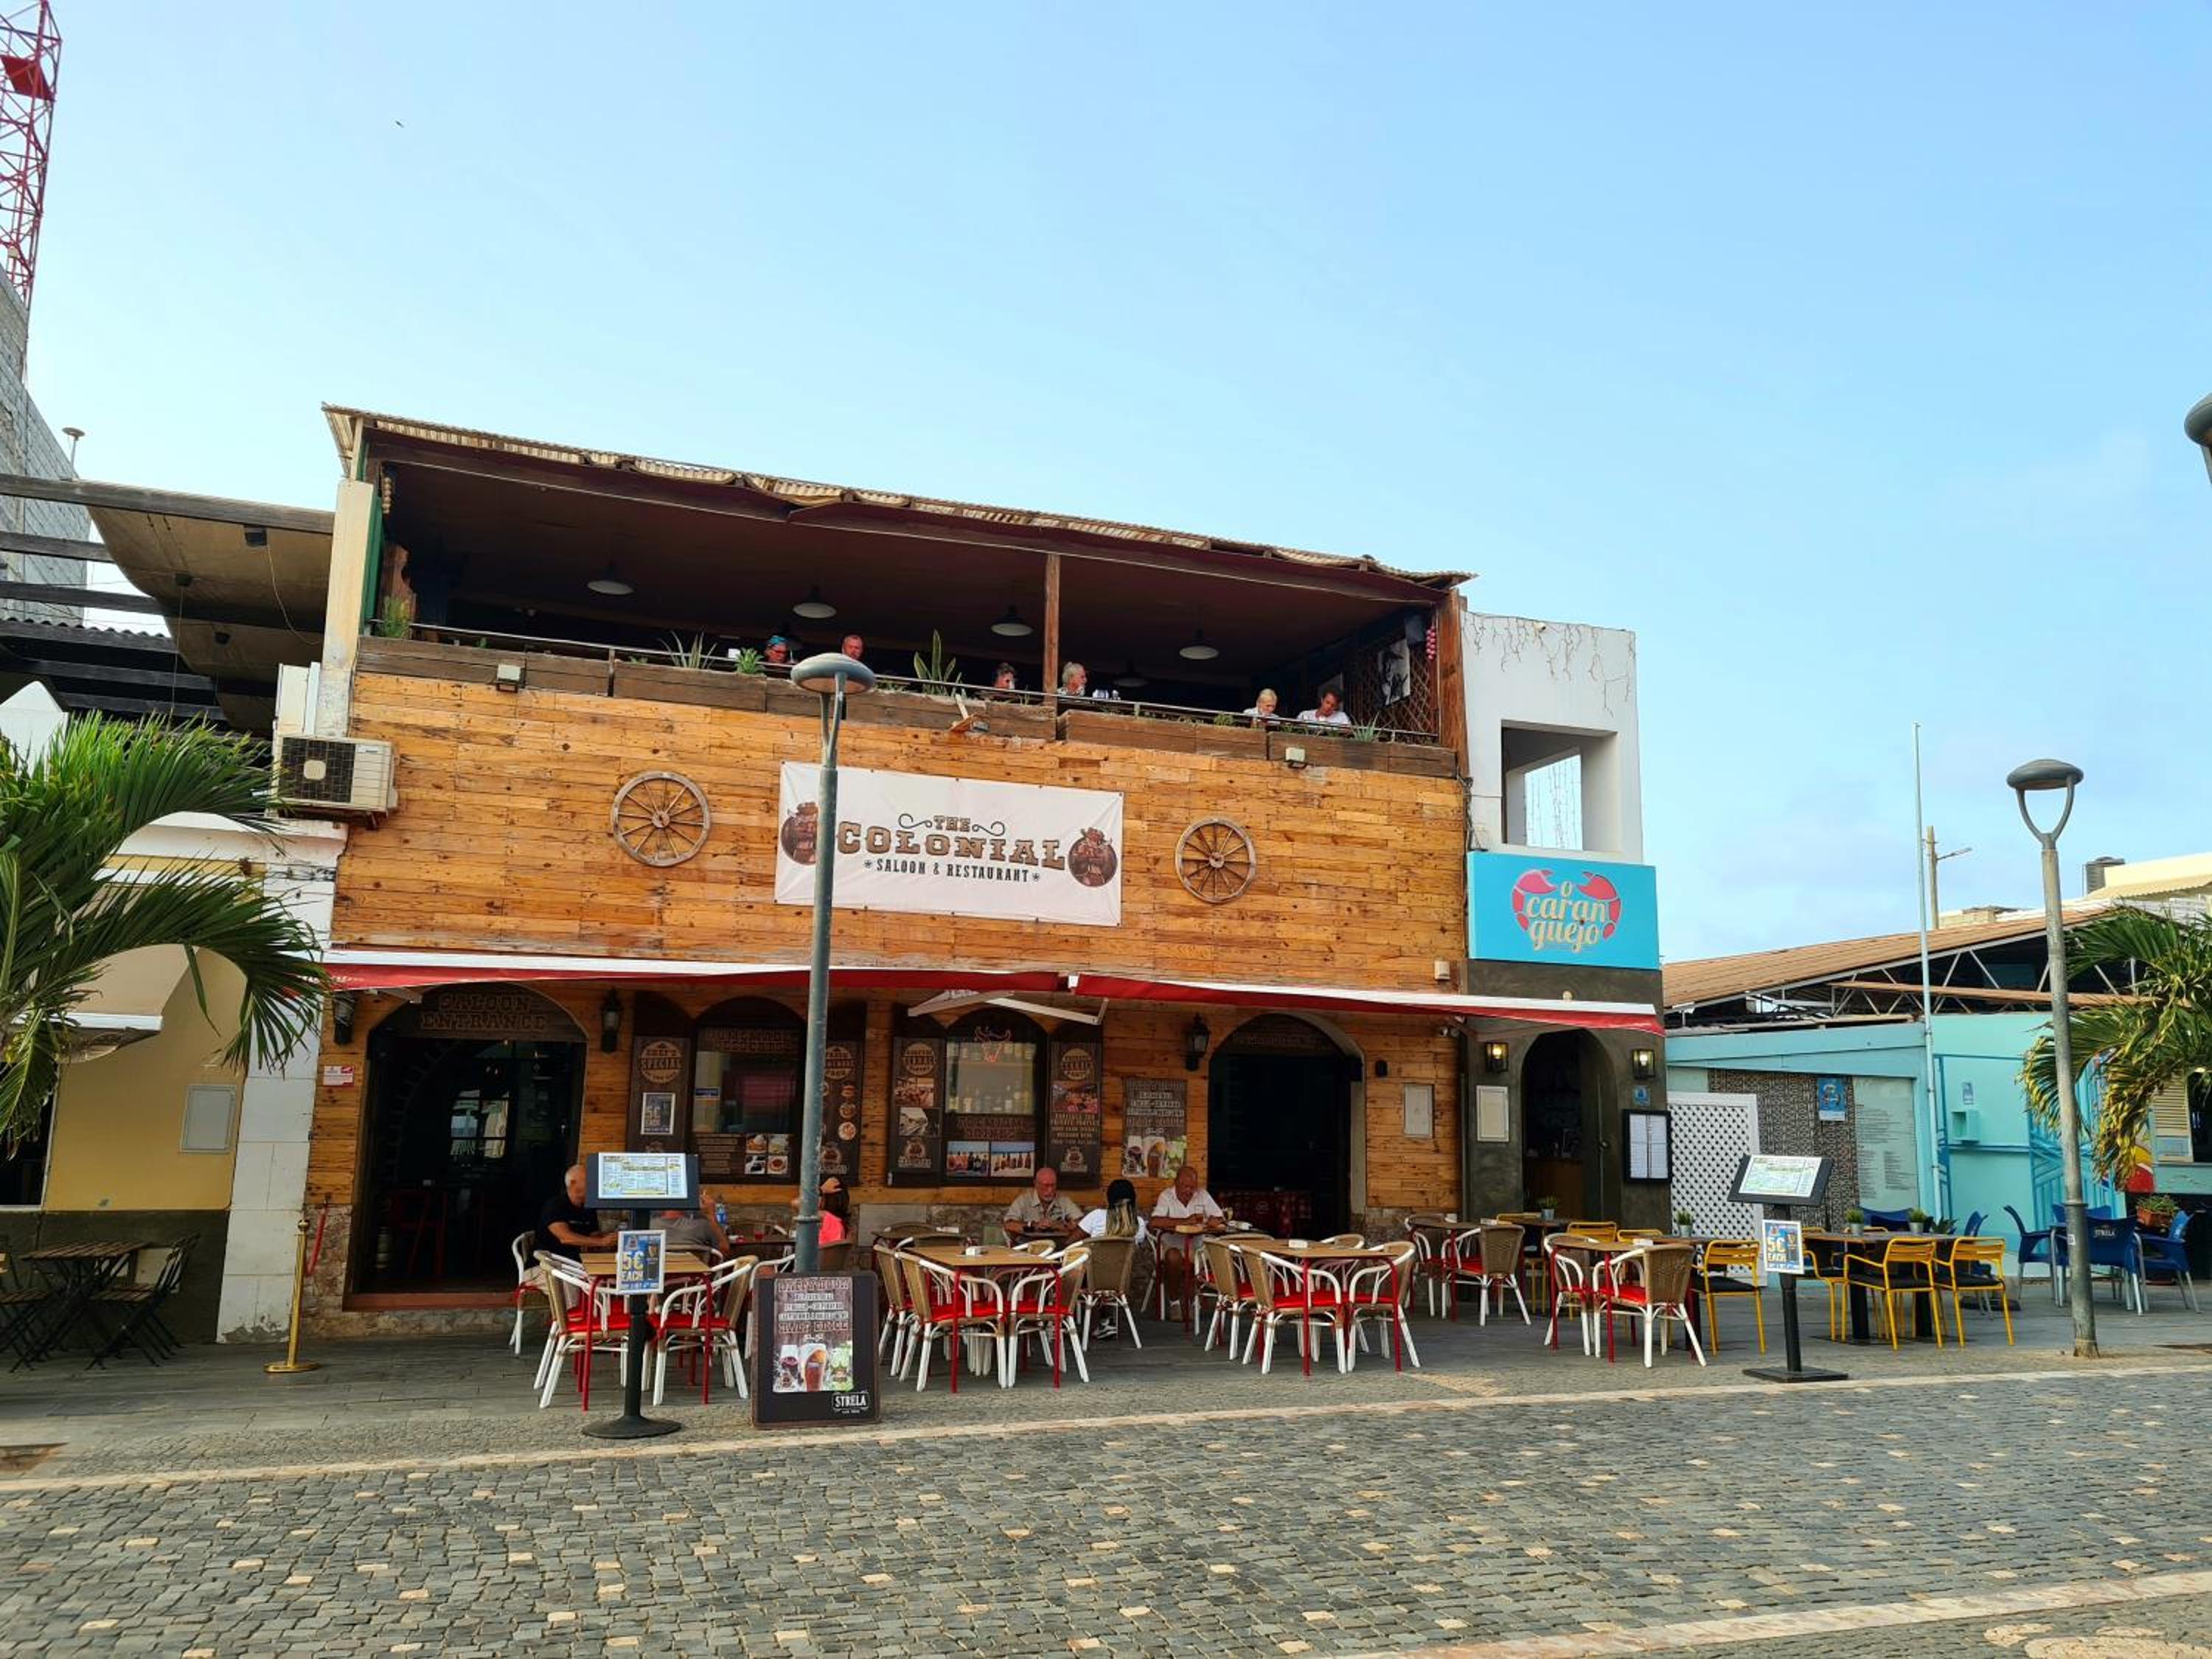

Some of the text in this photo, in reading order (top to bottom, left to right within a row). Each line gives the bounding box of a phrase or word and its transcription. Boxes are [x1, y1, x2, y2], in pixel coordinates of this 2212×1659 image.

[933, 815, 971, 832] THE
[837, 821, 1065, 871] COLONIAL
[877, 858, 1029, 883] SALOON & RESTAURANT
[1526, 897, 1607, 923] caran
[1529, 920, 1601, 953] guejo
[439, 993, 531, 1012] SALOON
[421, 1013, 549, 1031] ENTRANCE
[641, 1057, 681, 1069] SPECIAL
[622, 1251, 645, 1270] 5€
[621, 1270, 644, 1281] EACH
[835, 1394, 866, 1408] STRELA
